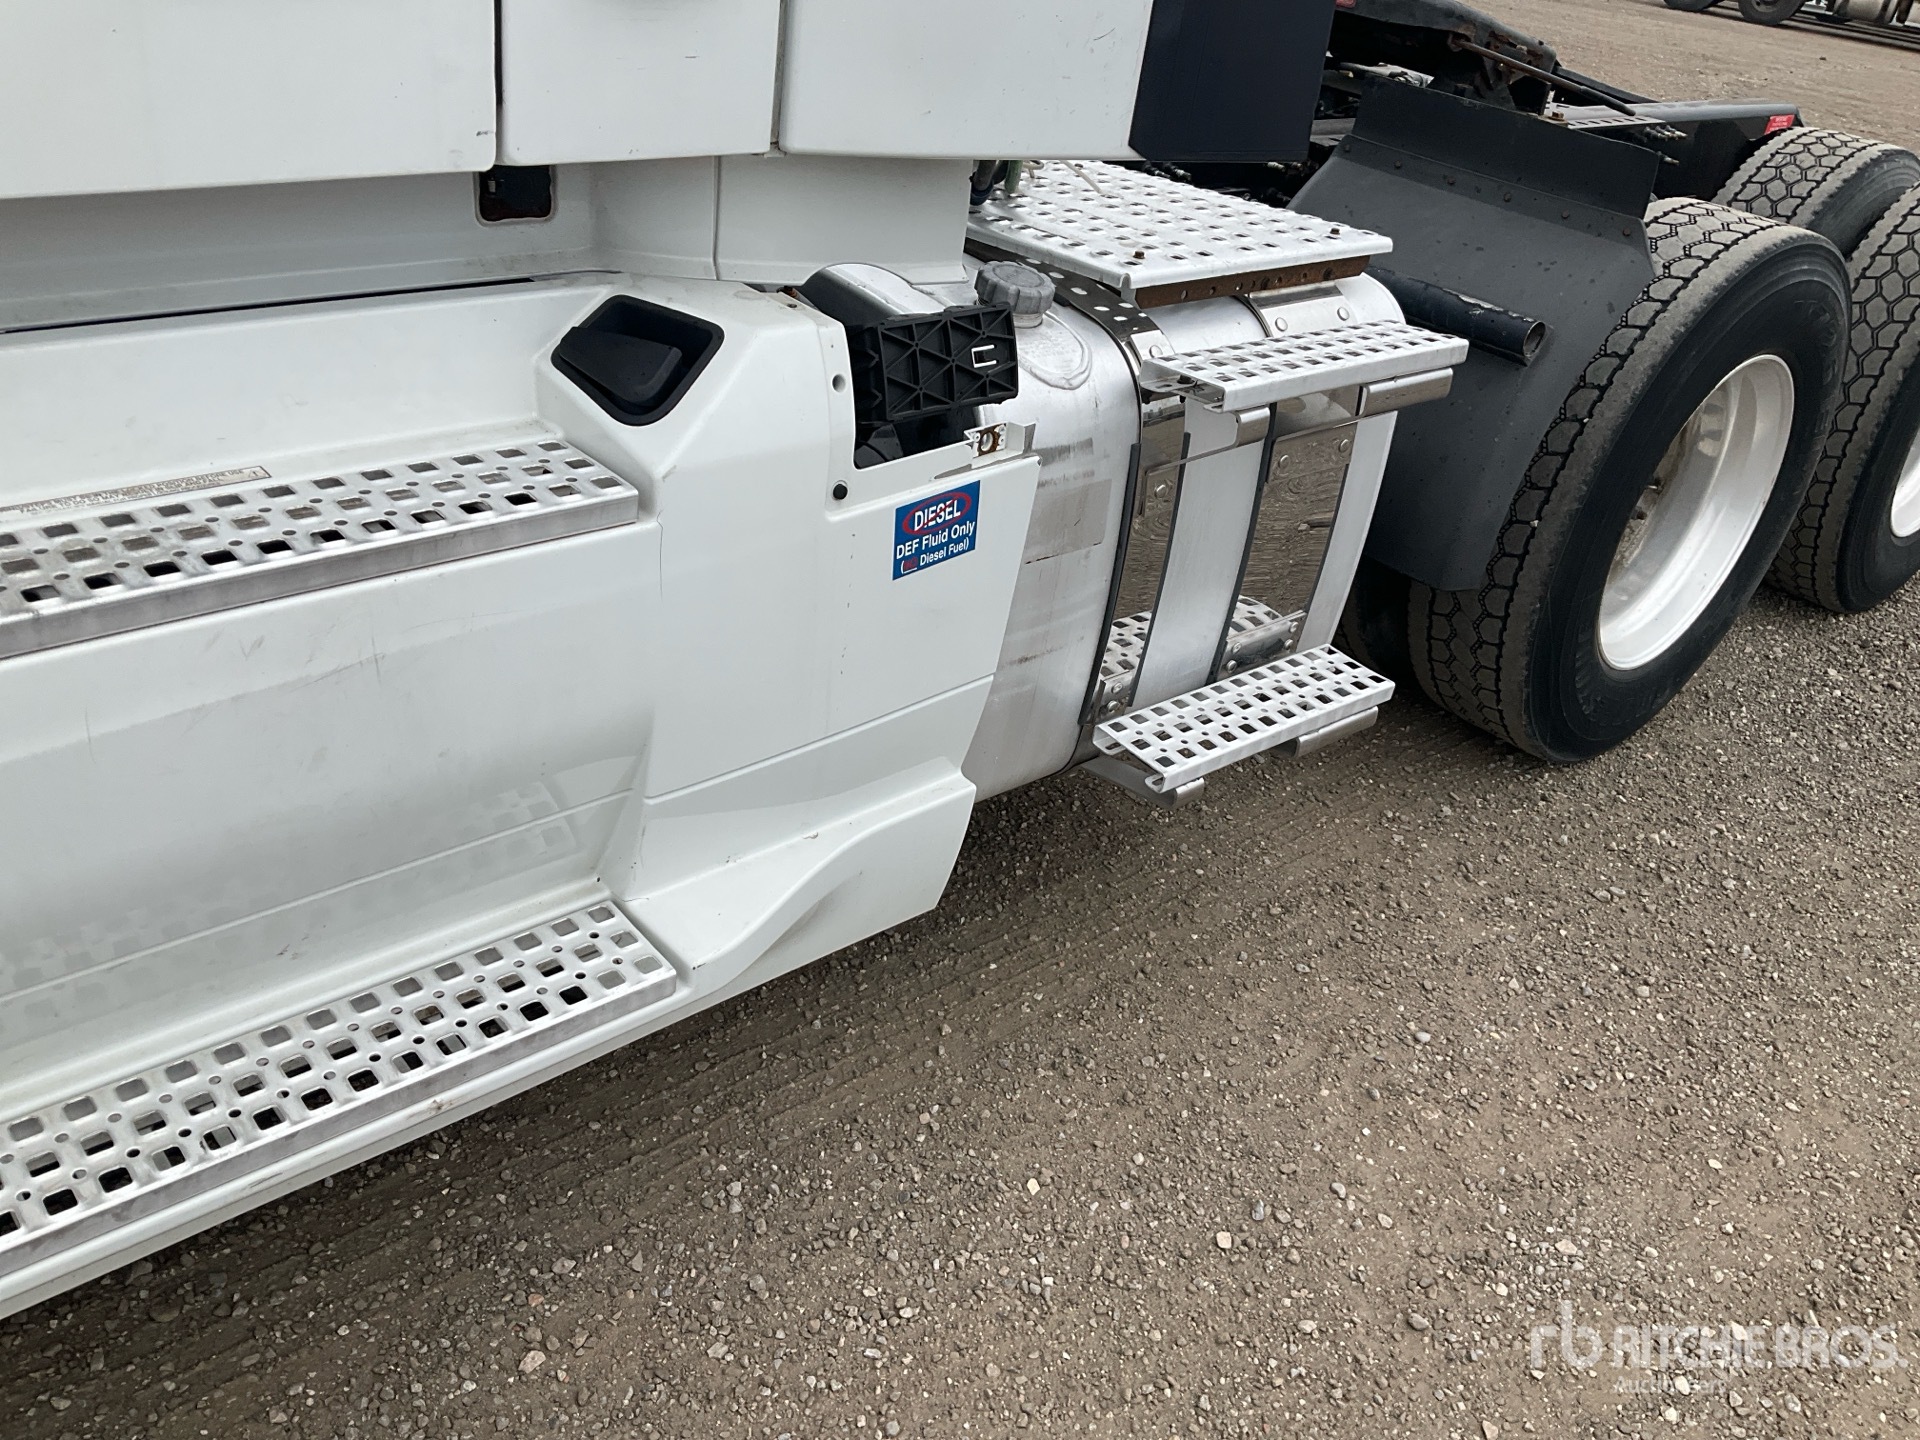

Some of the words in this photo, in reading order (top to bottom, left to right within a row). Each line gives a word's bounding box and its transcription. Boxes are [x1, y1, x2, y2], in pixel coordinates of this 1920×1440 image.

[914, 499, 961, 532] DIESEL
[896, 538, 919, 560] DEF
[921, 532, 948, 551] Fluid
[950, 520, 976, 539] Only
[919, 546, 947, 566] Diesel
[948, 537, 970, 556] Fuel)
